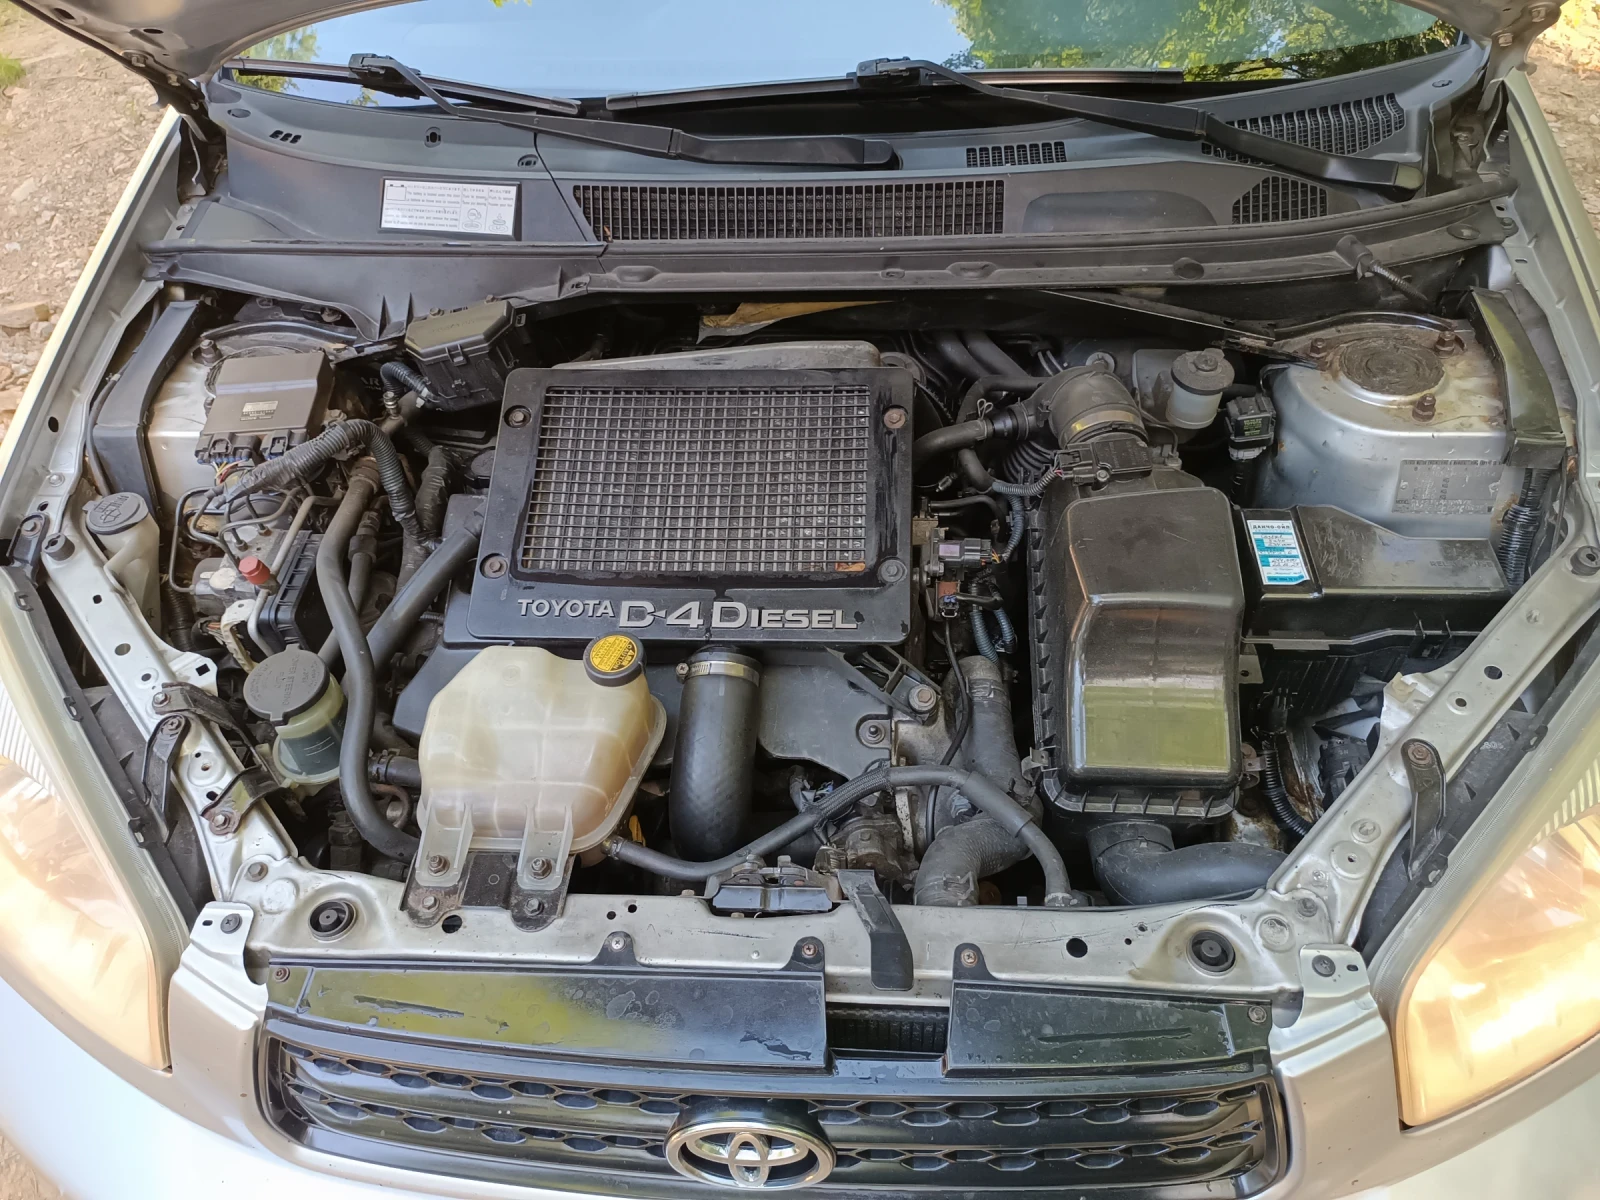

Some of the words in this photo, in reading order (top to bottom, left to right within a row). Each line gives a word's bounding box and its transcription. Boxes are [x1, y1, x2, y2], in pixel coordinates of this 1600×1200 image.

[517, 599, 615, 618] TOYOTA
[619, 600, 703, 629] D-4
[711, 600, 858, 630] DIESEL
